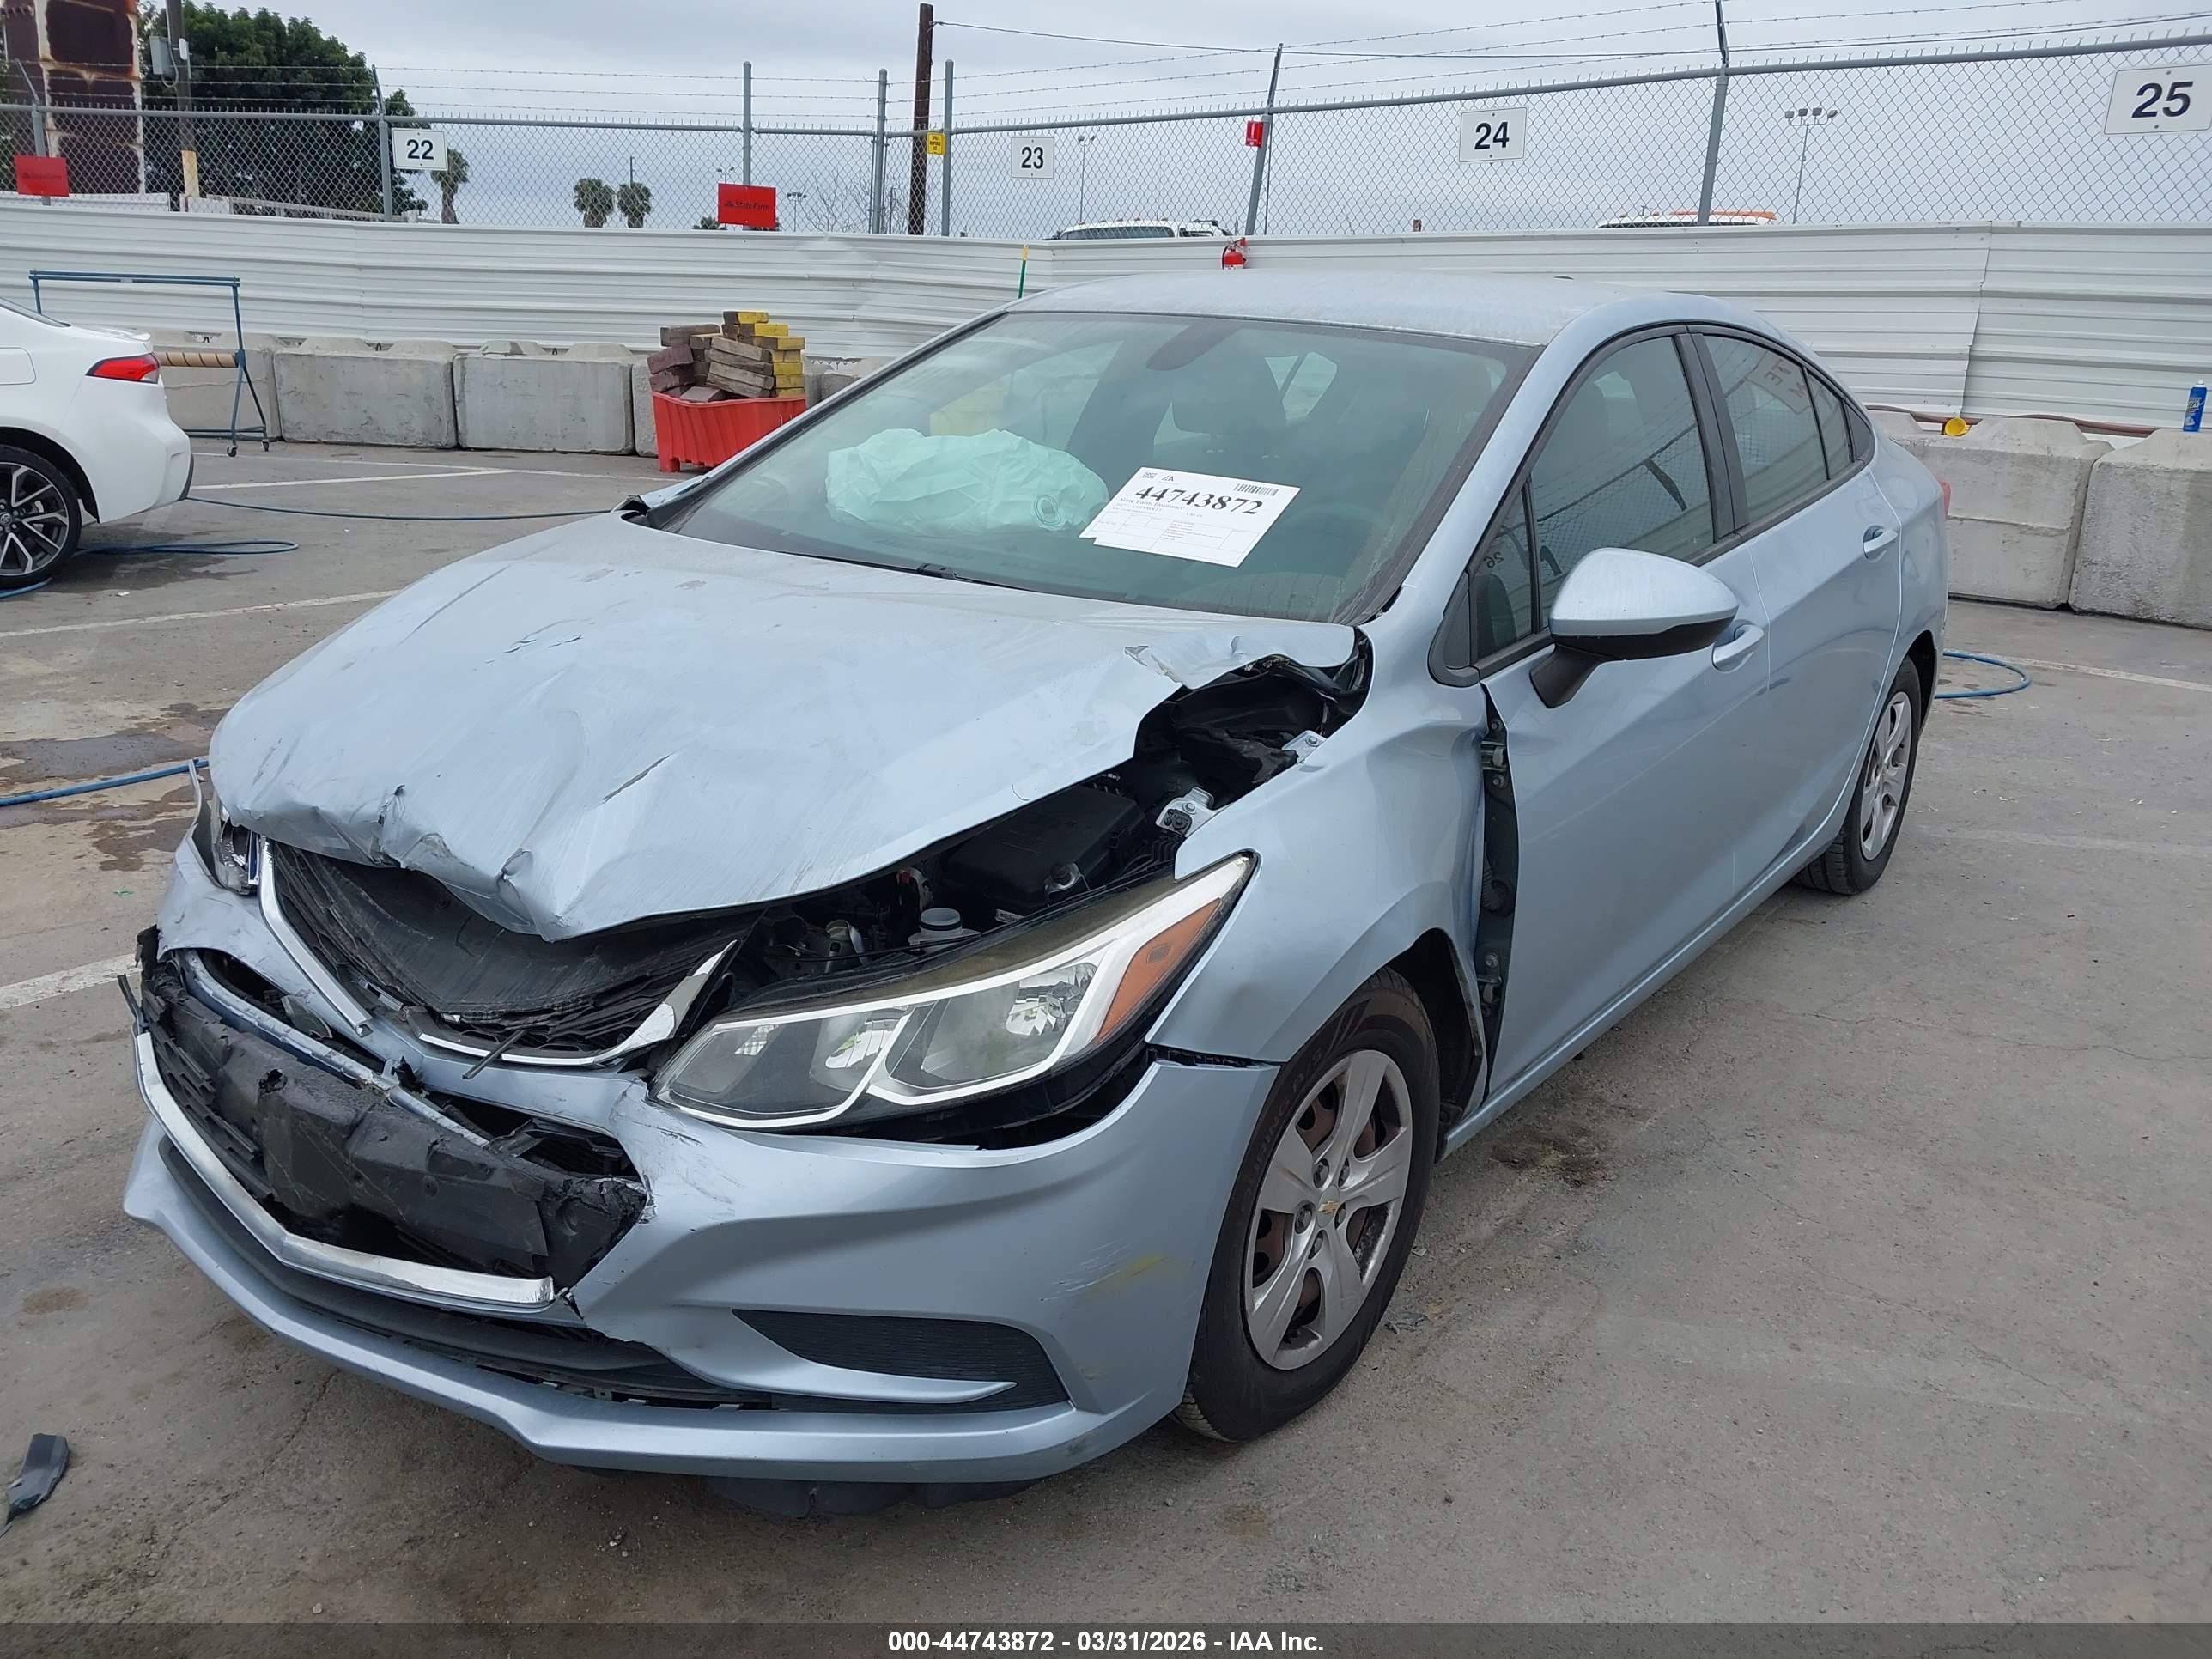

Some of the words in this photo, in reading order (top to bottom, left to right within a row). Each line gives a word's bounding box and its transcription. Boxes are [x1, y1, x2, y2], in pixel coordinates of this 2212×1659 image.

[2131, 81, 2194, 118] 25
[406, 138, 434, 161] 22
[1474, 122, 1510, 150] 24
[1021, 146, 1044, 169] 23
[1135, 486, 1263, 514] 44743872
